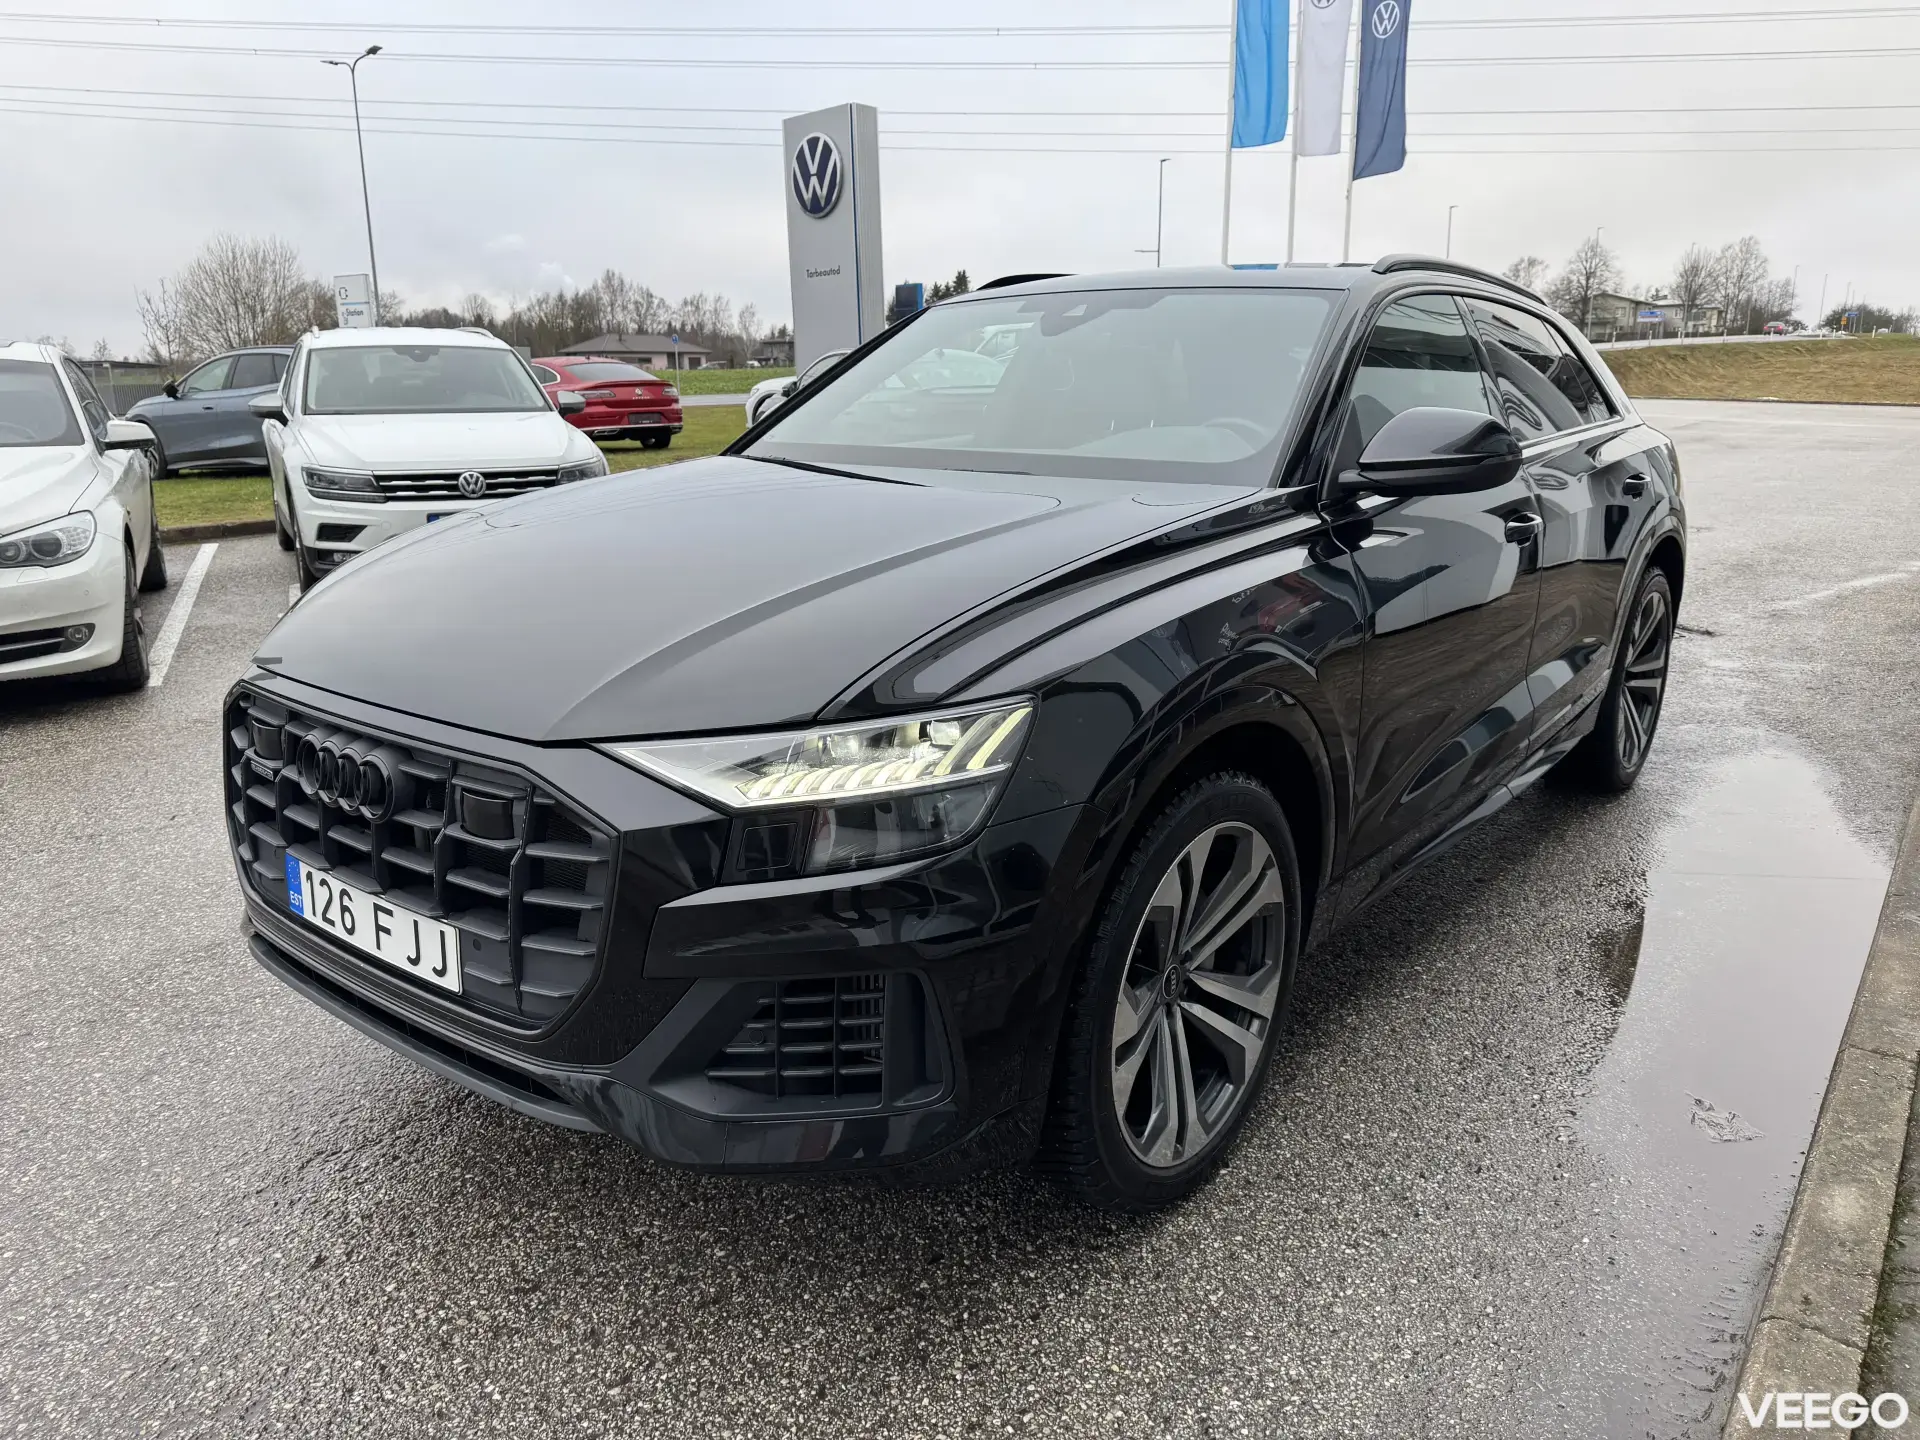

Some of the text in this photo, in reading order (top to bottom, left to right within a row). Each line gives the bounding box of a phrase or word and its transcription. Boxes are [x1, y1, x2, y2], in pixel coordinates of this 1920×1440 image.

[793, 135, 841, 215] VW
[459, 471, 487, 498] VW
[289, 890, 303, 908] EST
[305, 870, 448, 978] 126 FJJ
